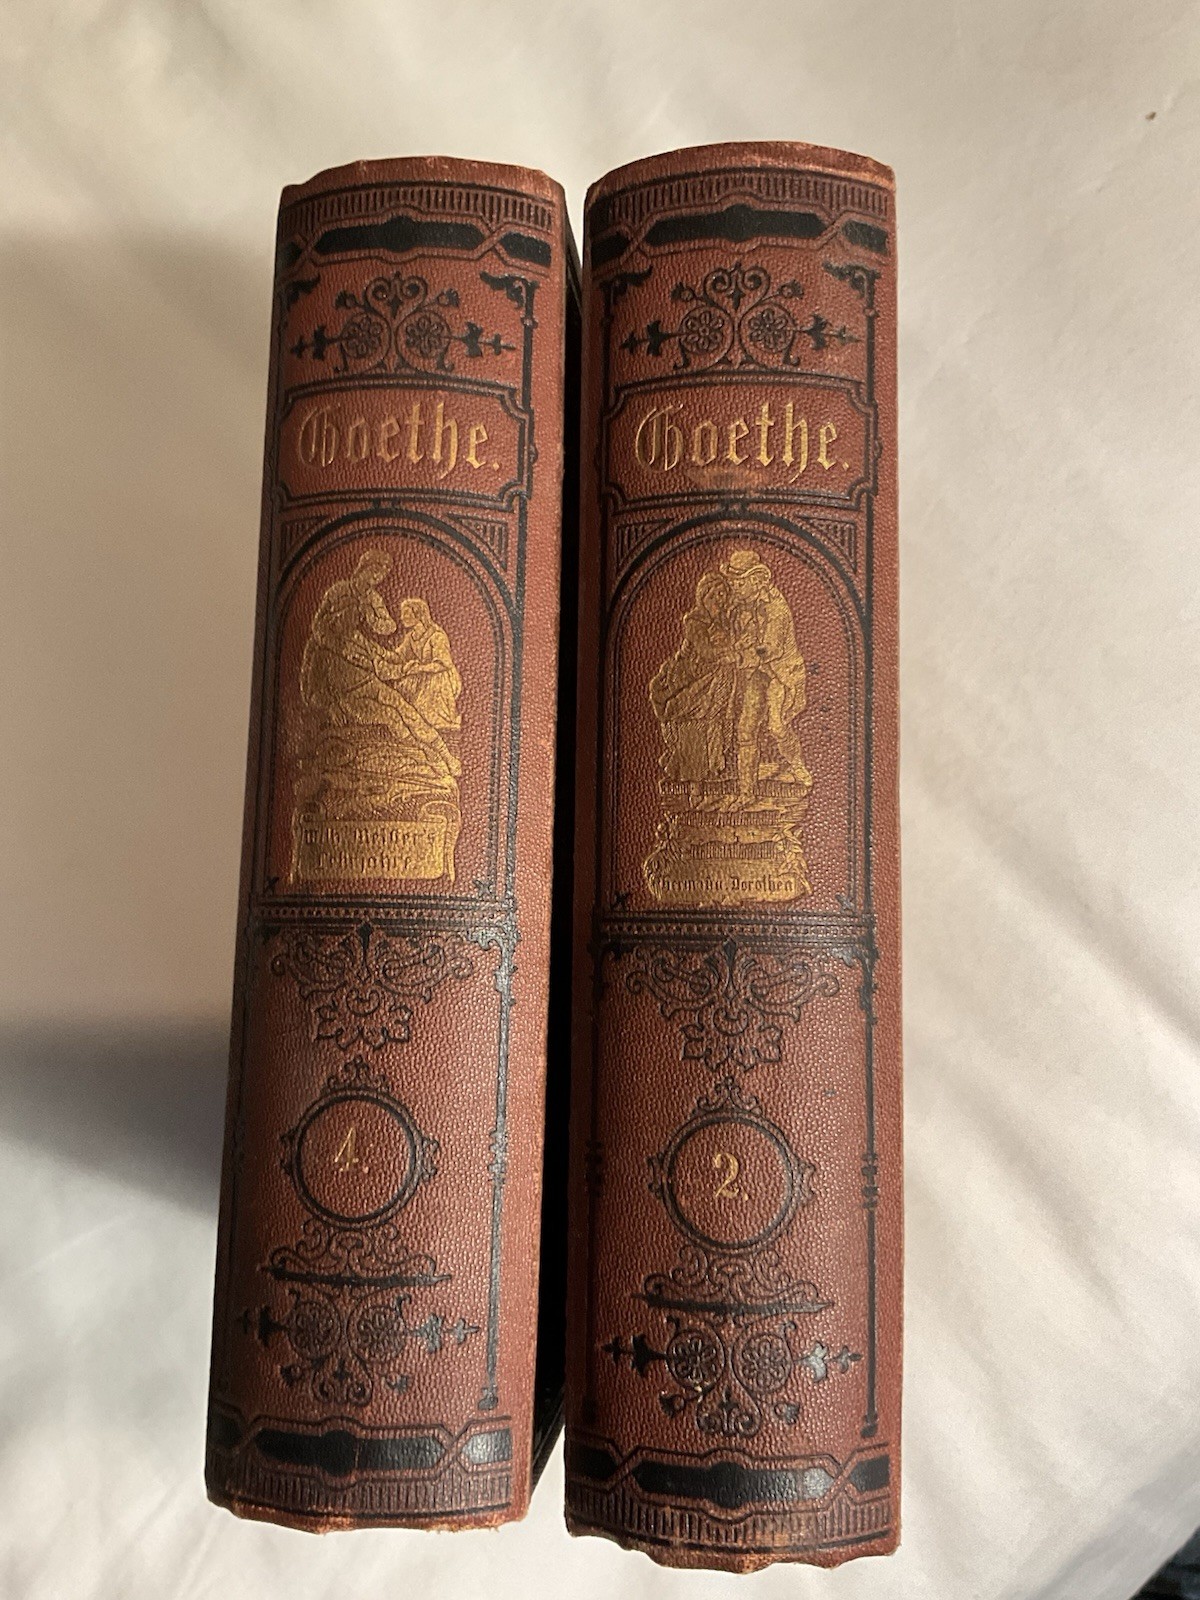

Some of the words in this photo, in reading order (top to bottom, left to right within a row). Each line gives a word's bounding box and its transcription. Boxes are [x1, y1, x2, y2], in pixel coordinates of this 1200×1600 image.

[298, 400, 500, 480] Goethe.
[636, 401, 850, 483] Goethe.
[714, 1152, 749, 1201] 2.
